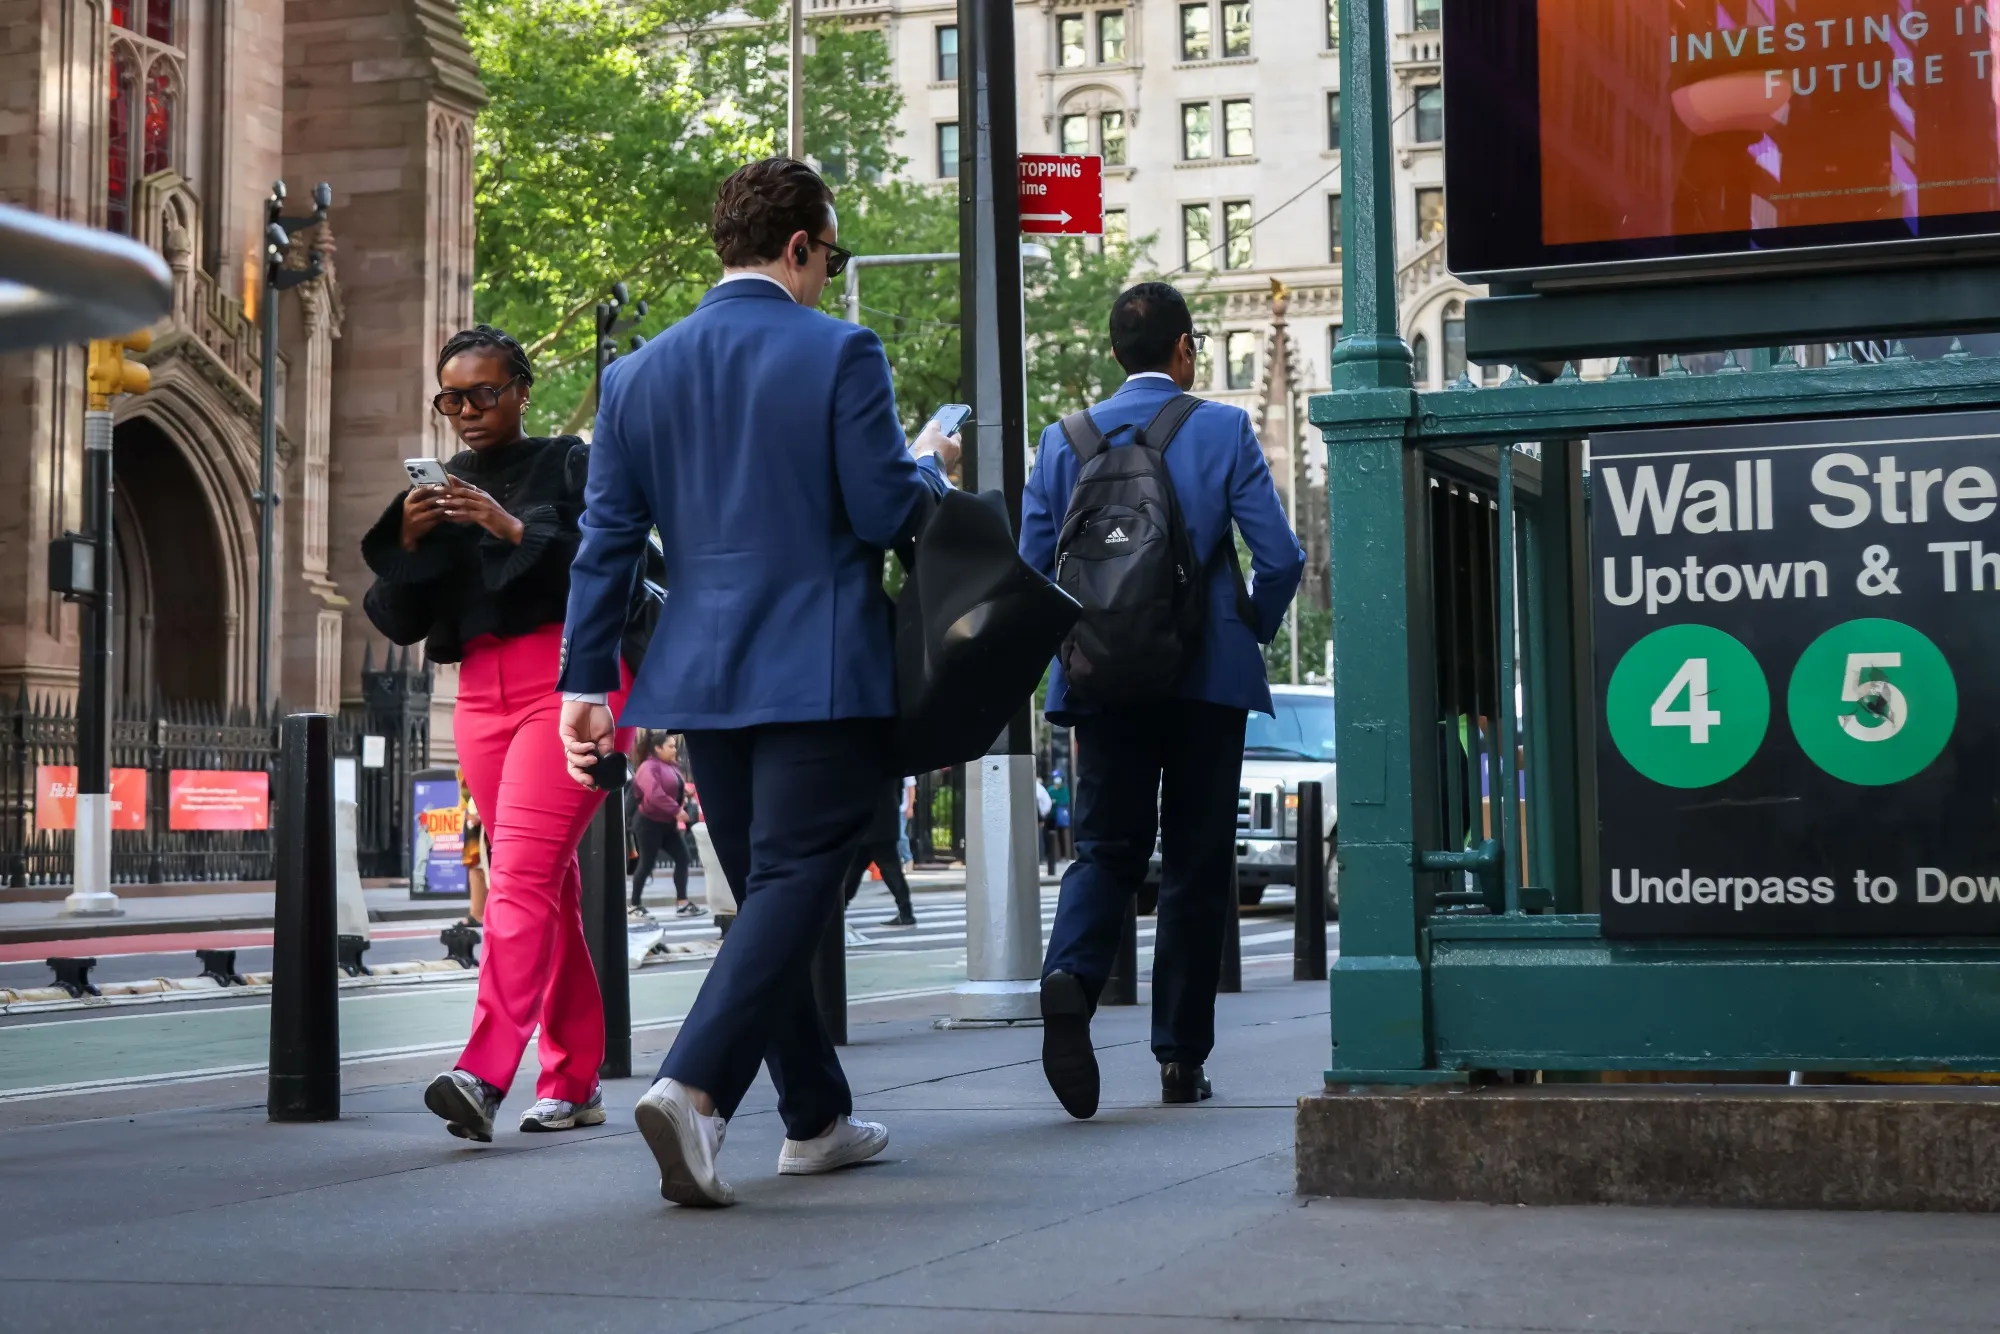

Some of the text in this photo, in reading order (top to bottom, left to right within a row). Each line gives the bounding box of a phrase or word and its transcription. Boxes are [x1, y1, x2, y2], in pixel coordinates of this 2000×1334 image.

[1670, 10, 1929, 63] INVESTING
[1765, 54, 1943, 99] FUTURE
[1020, 162, 1081, 178] TOPPING
[1021, 180, 1047, 195] ime
[1602, 452, 1998, 536] Wall Stre
[1603, 540, 2000, 615] Uptown & Th
[1650, 658, 1721, 744] 4
[1837, 652, 1908, 742] 5
[429, 813, 461, 832] DINE
[1612, 867, 2000, 911] Underpass to Dow
